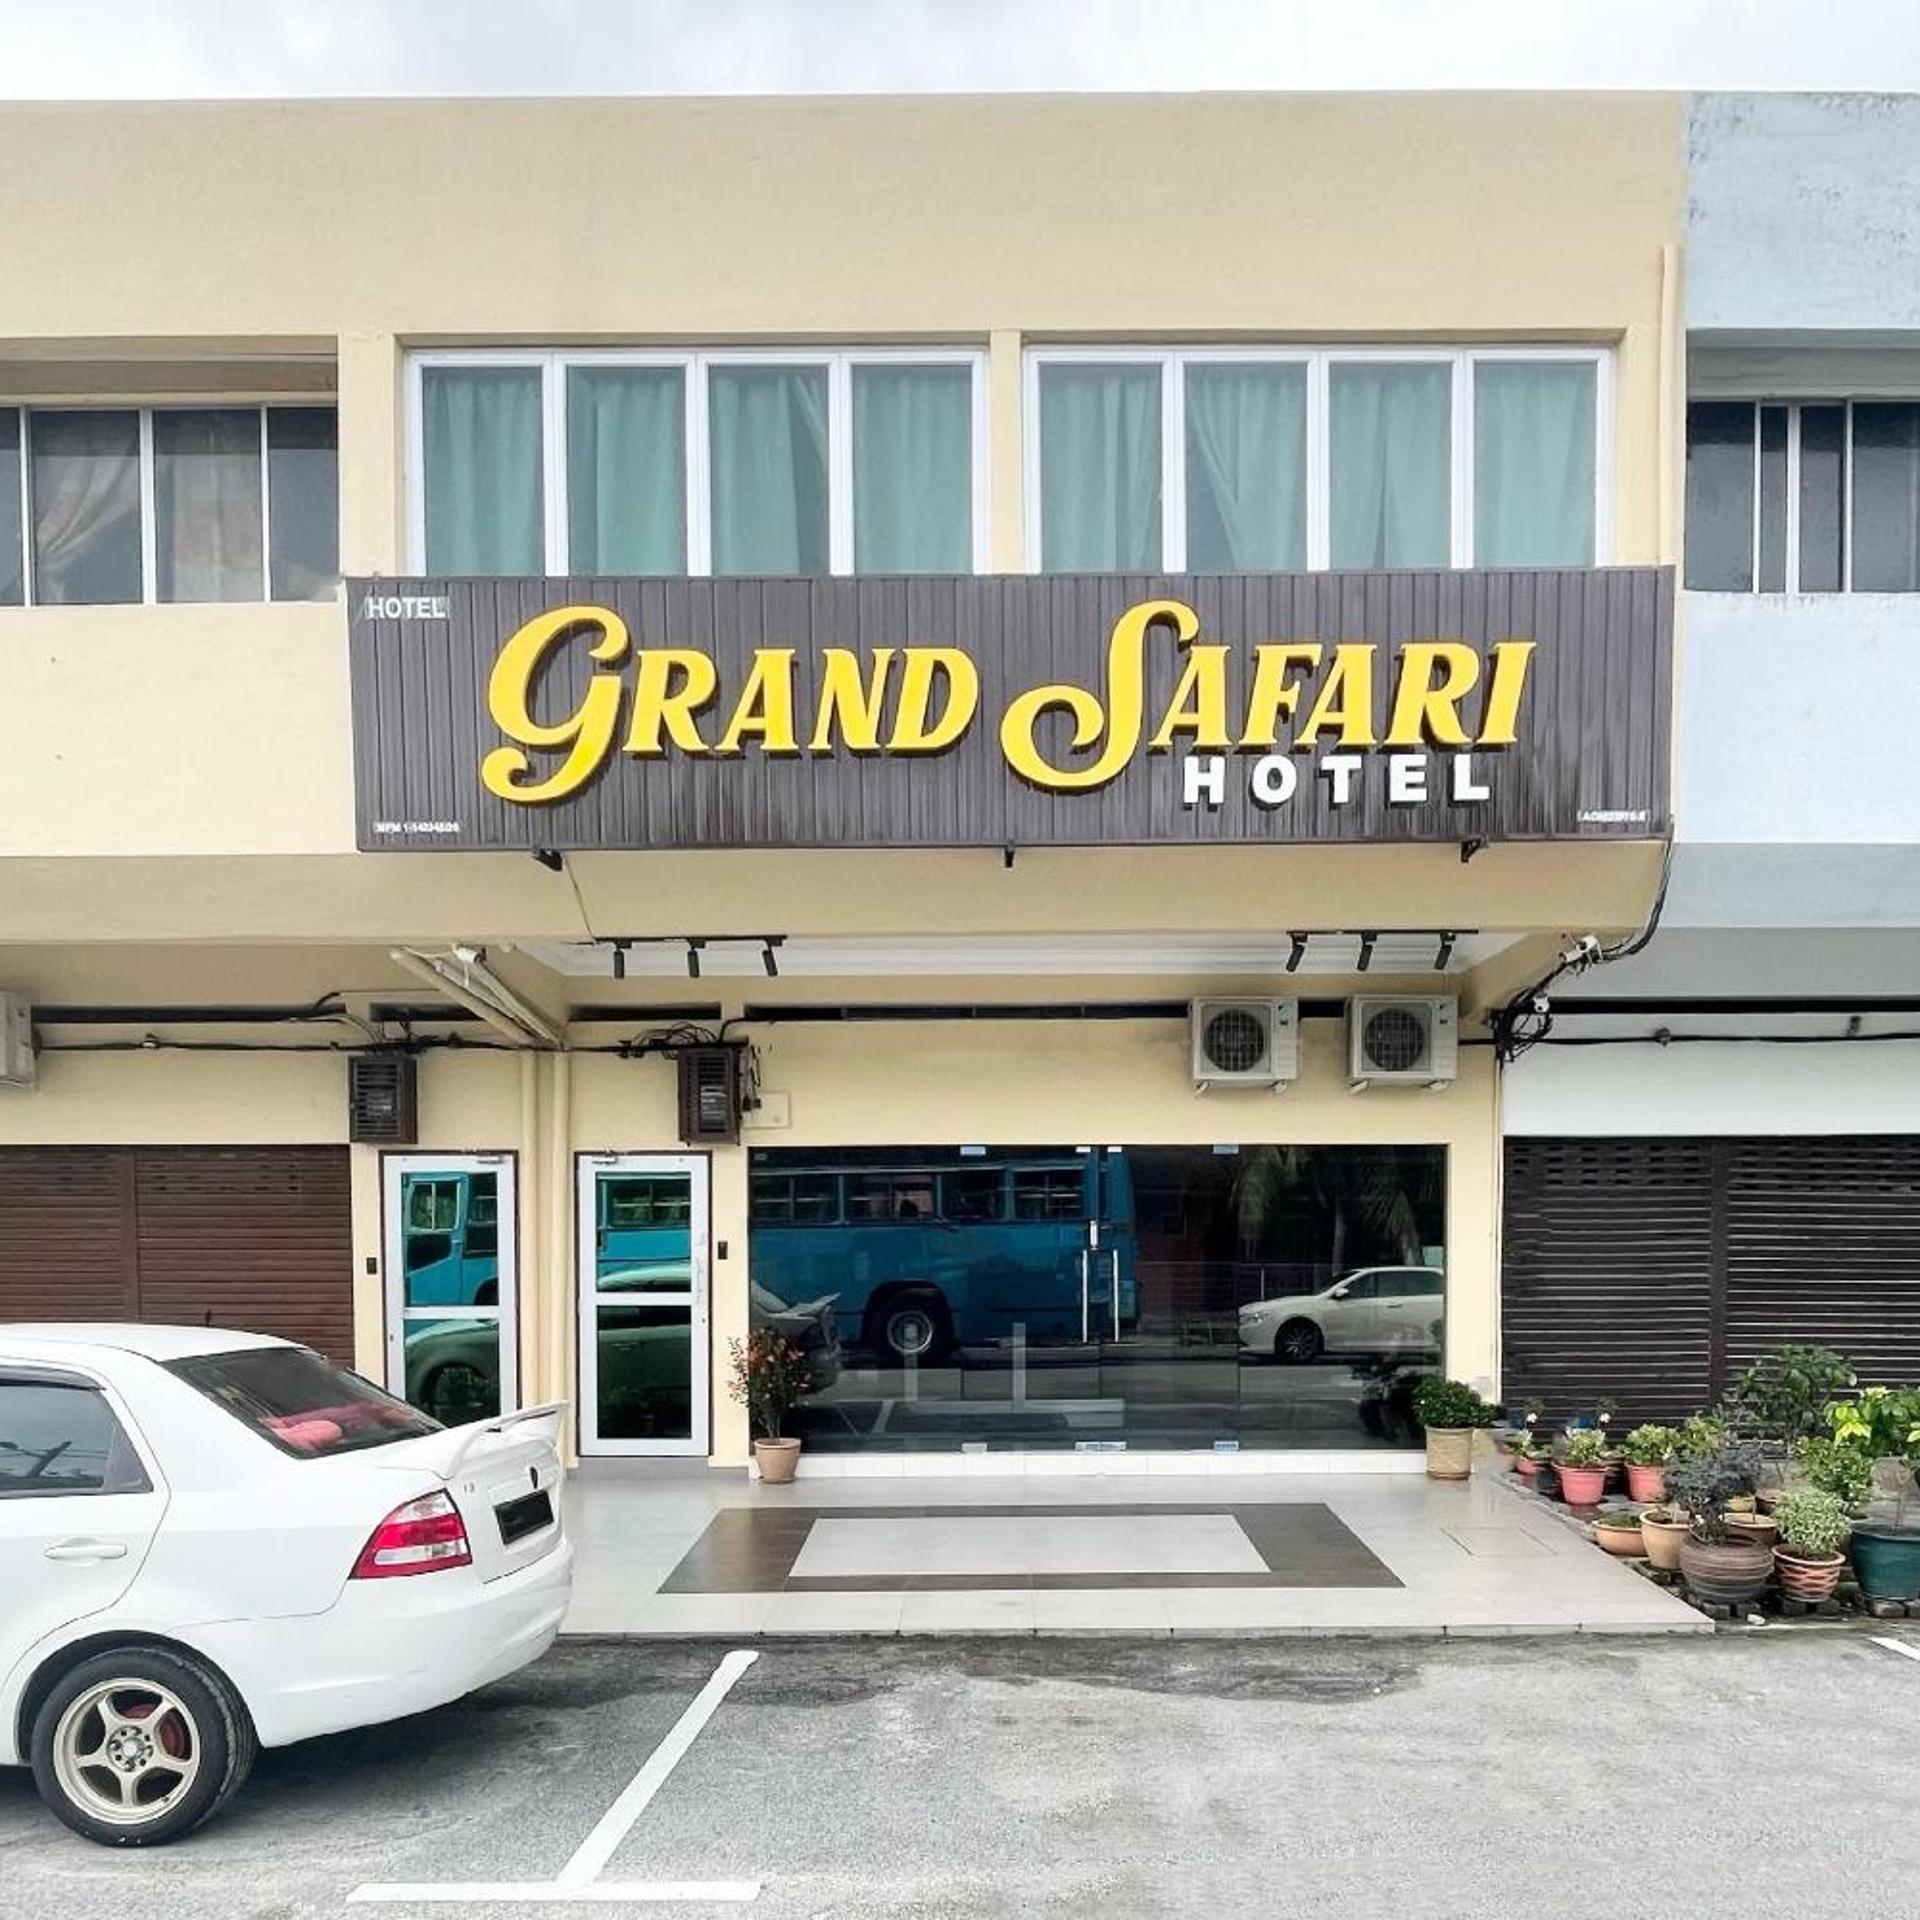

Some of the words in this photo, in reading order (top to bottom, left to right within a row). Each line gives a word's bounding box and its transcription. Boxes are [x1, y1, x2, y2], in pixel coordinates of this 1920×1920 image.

[366, 596, 446, 619] HOTEL
[481, 605, 979, 803] GRAND
[1000, 600, 1536, 788] SAFARI
[1184, 754, 1490, 804] HOTEL
